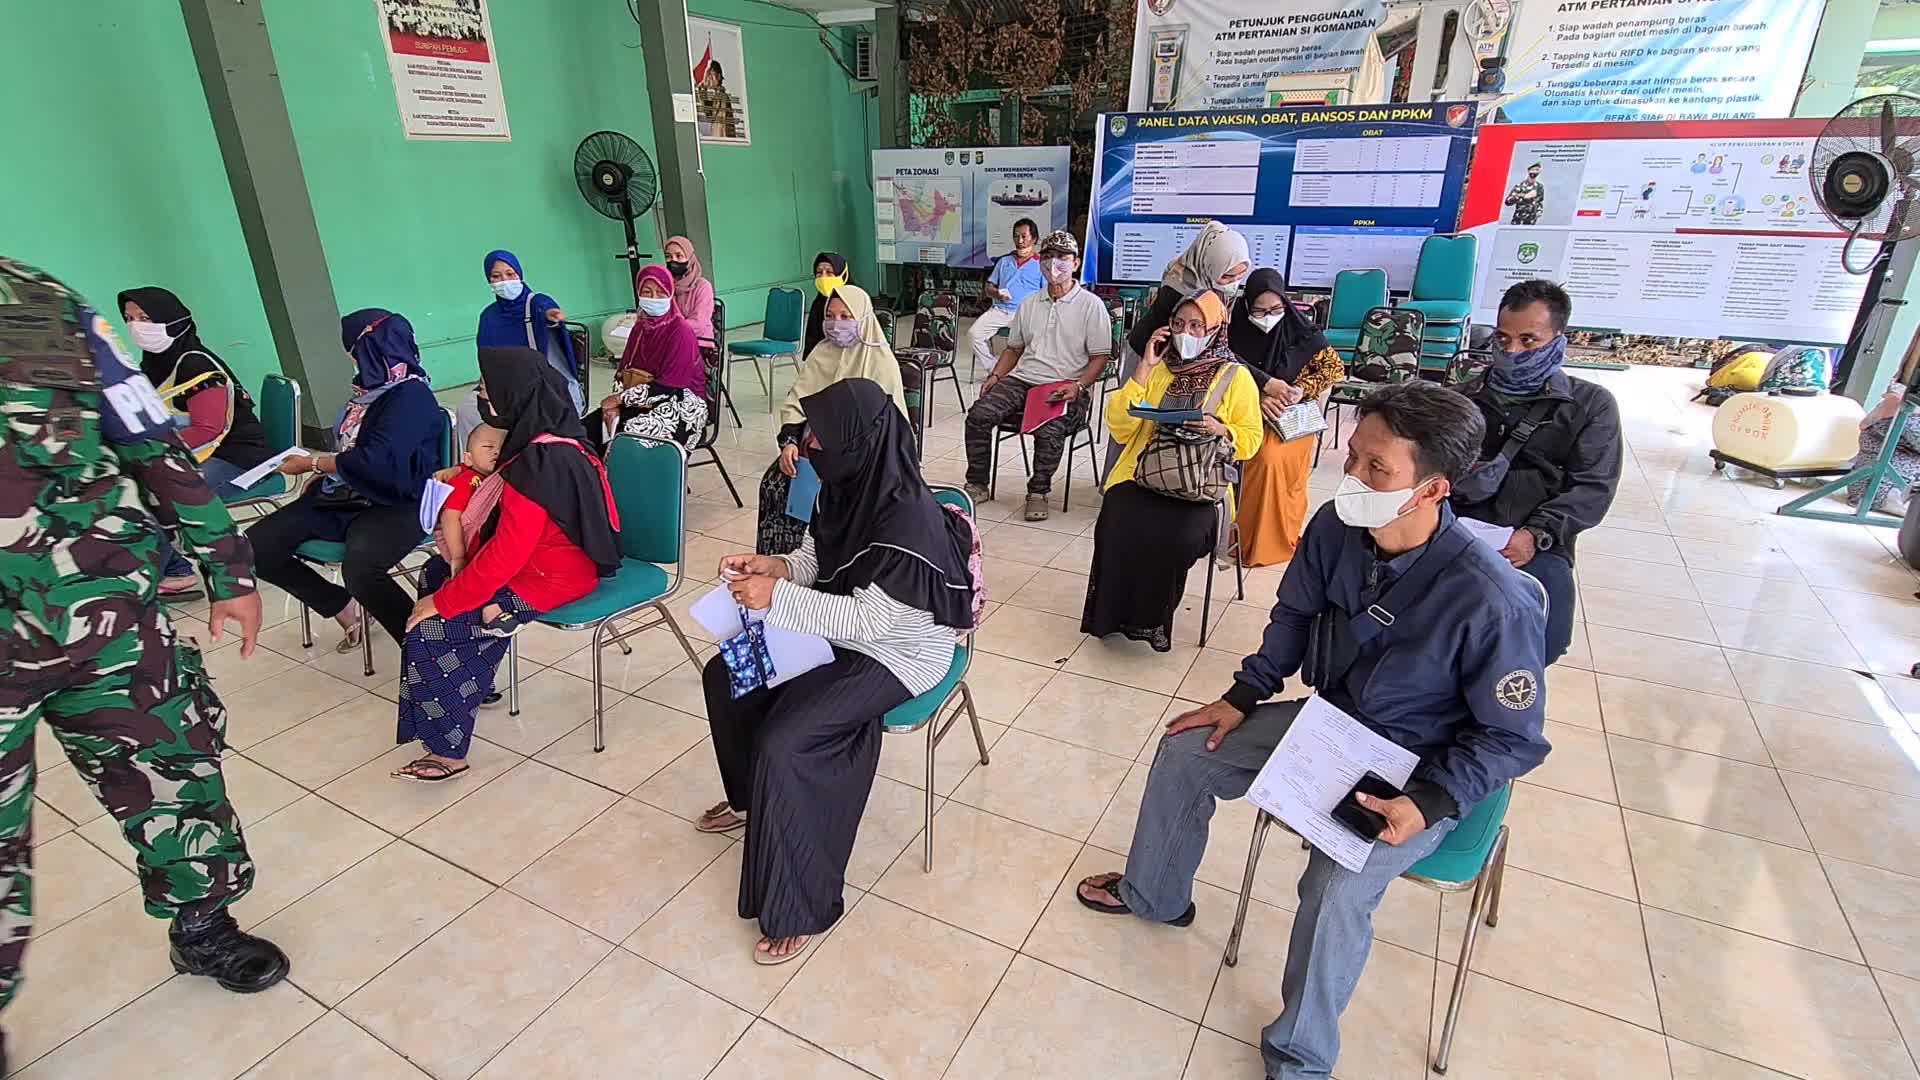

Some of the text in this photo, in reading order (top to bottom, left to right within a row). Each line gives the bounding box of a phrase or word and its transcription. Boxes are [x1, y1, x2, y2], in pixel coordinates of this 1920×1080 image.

[1557, 2, 1587, 12] ATM
[1229, 8, 1364, 28] PETUNJUK PENGGUNAAN
[1558, 23, 1579, 33] Siap
[1582, 21, 1613, 31] wadah
[1615, 18, 1675, 30] penampung
[1678, 15, 1706, 24] beras
[1215, 19, 1376, 41] ATM PERTANIAN SI KOMANDAN
[1556, 33, 1580, 41] Pada
[1582, 31, 1615, 42] bagian
[1618, 29, 1646, 38] outlet
[1648, 26, 1679, 36] mesin
[1682, 25, 1692, 34] di
[1694, 23, 1729, 35] bagian
[1216, 49, 1232, 58] Siap
[1233, 48, 1256, 56] wadah
[1257, 46, 1299, 57] penampung
[1234, 57, 1257, 65] bagian
[1281, 54, 1303, 62] mesin
[1313, 51, 1339, 60] bagian
[1340, 47, 1365, 57] bawah
[1553, 51, 1590, 61] Tapping
[1592, 50, 1617, 58] kartu
[1620, 48, 1644, 57] RIFD
[1646, 48, 1658, 56] ke
[1660, 46, 1695, 56] bagian
[1698, 45, 1732, 53] sensor
[1735, 44, 1760, 54] yang
[1551, 59, 1636, 69] Tersedia di mesin.
[1214, 73, 1240, 81] Tapping
[1261, 71, 1279, 79] RIFD
[1547, 80, 1581, 88] Tunggu
[1583, 79, 1628, 88] beberapa
[1630, 78, 1650, 86] saat
[1653, 76, 1687, 85] hingga
[1689, 75, 1718, 83] beras
[1544, 88, 1586, 97] Otomatis
[1588, 87, 1618, 95] keluar
[1620, 87, 1640, 95] dari
[1642, 86, 1669, 95] outlet
[1210, 97, 1235, 105] Tunggu
[1237, 96, 1265, 104] beberap
[1542, 98, 1559, 107] dan
[1561, 98, 1581, 107] siap
[1583, 97, 1610, 106] untuk
[1613, 96, 1665, 105] dimasukan
[1682, 95, 1724, 104] kantong
[1138, 108, 1433, 128] PANEL DATA VAKSIN, OBAT, BANSOS DAN PPKM
[1604, 113, 1638, 121] BERAS
[1641, 113, 1664, 121] SIAP
[1679, 112, 1708, 120] BAWA
[1711, 111, 1756, 120] PULANG
[895, 168, 939, 176] PETA ZONASI
